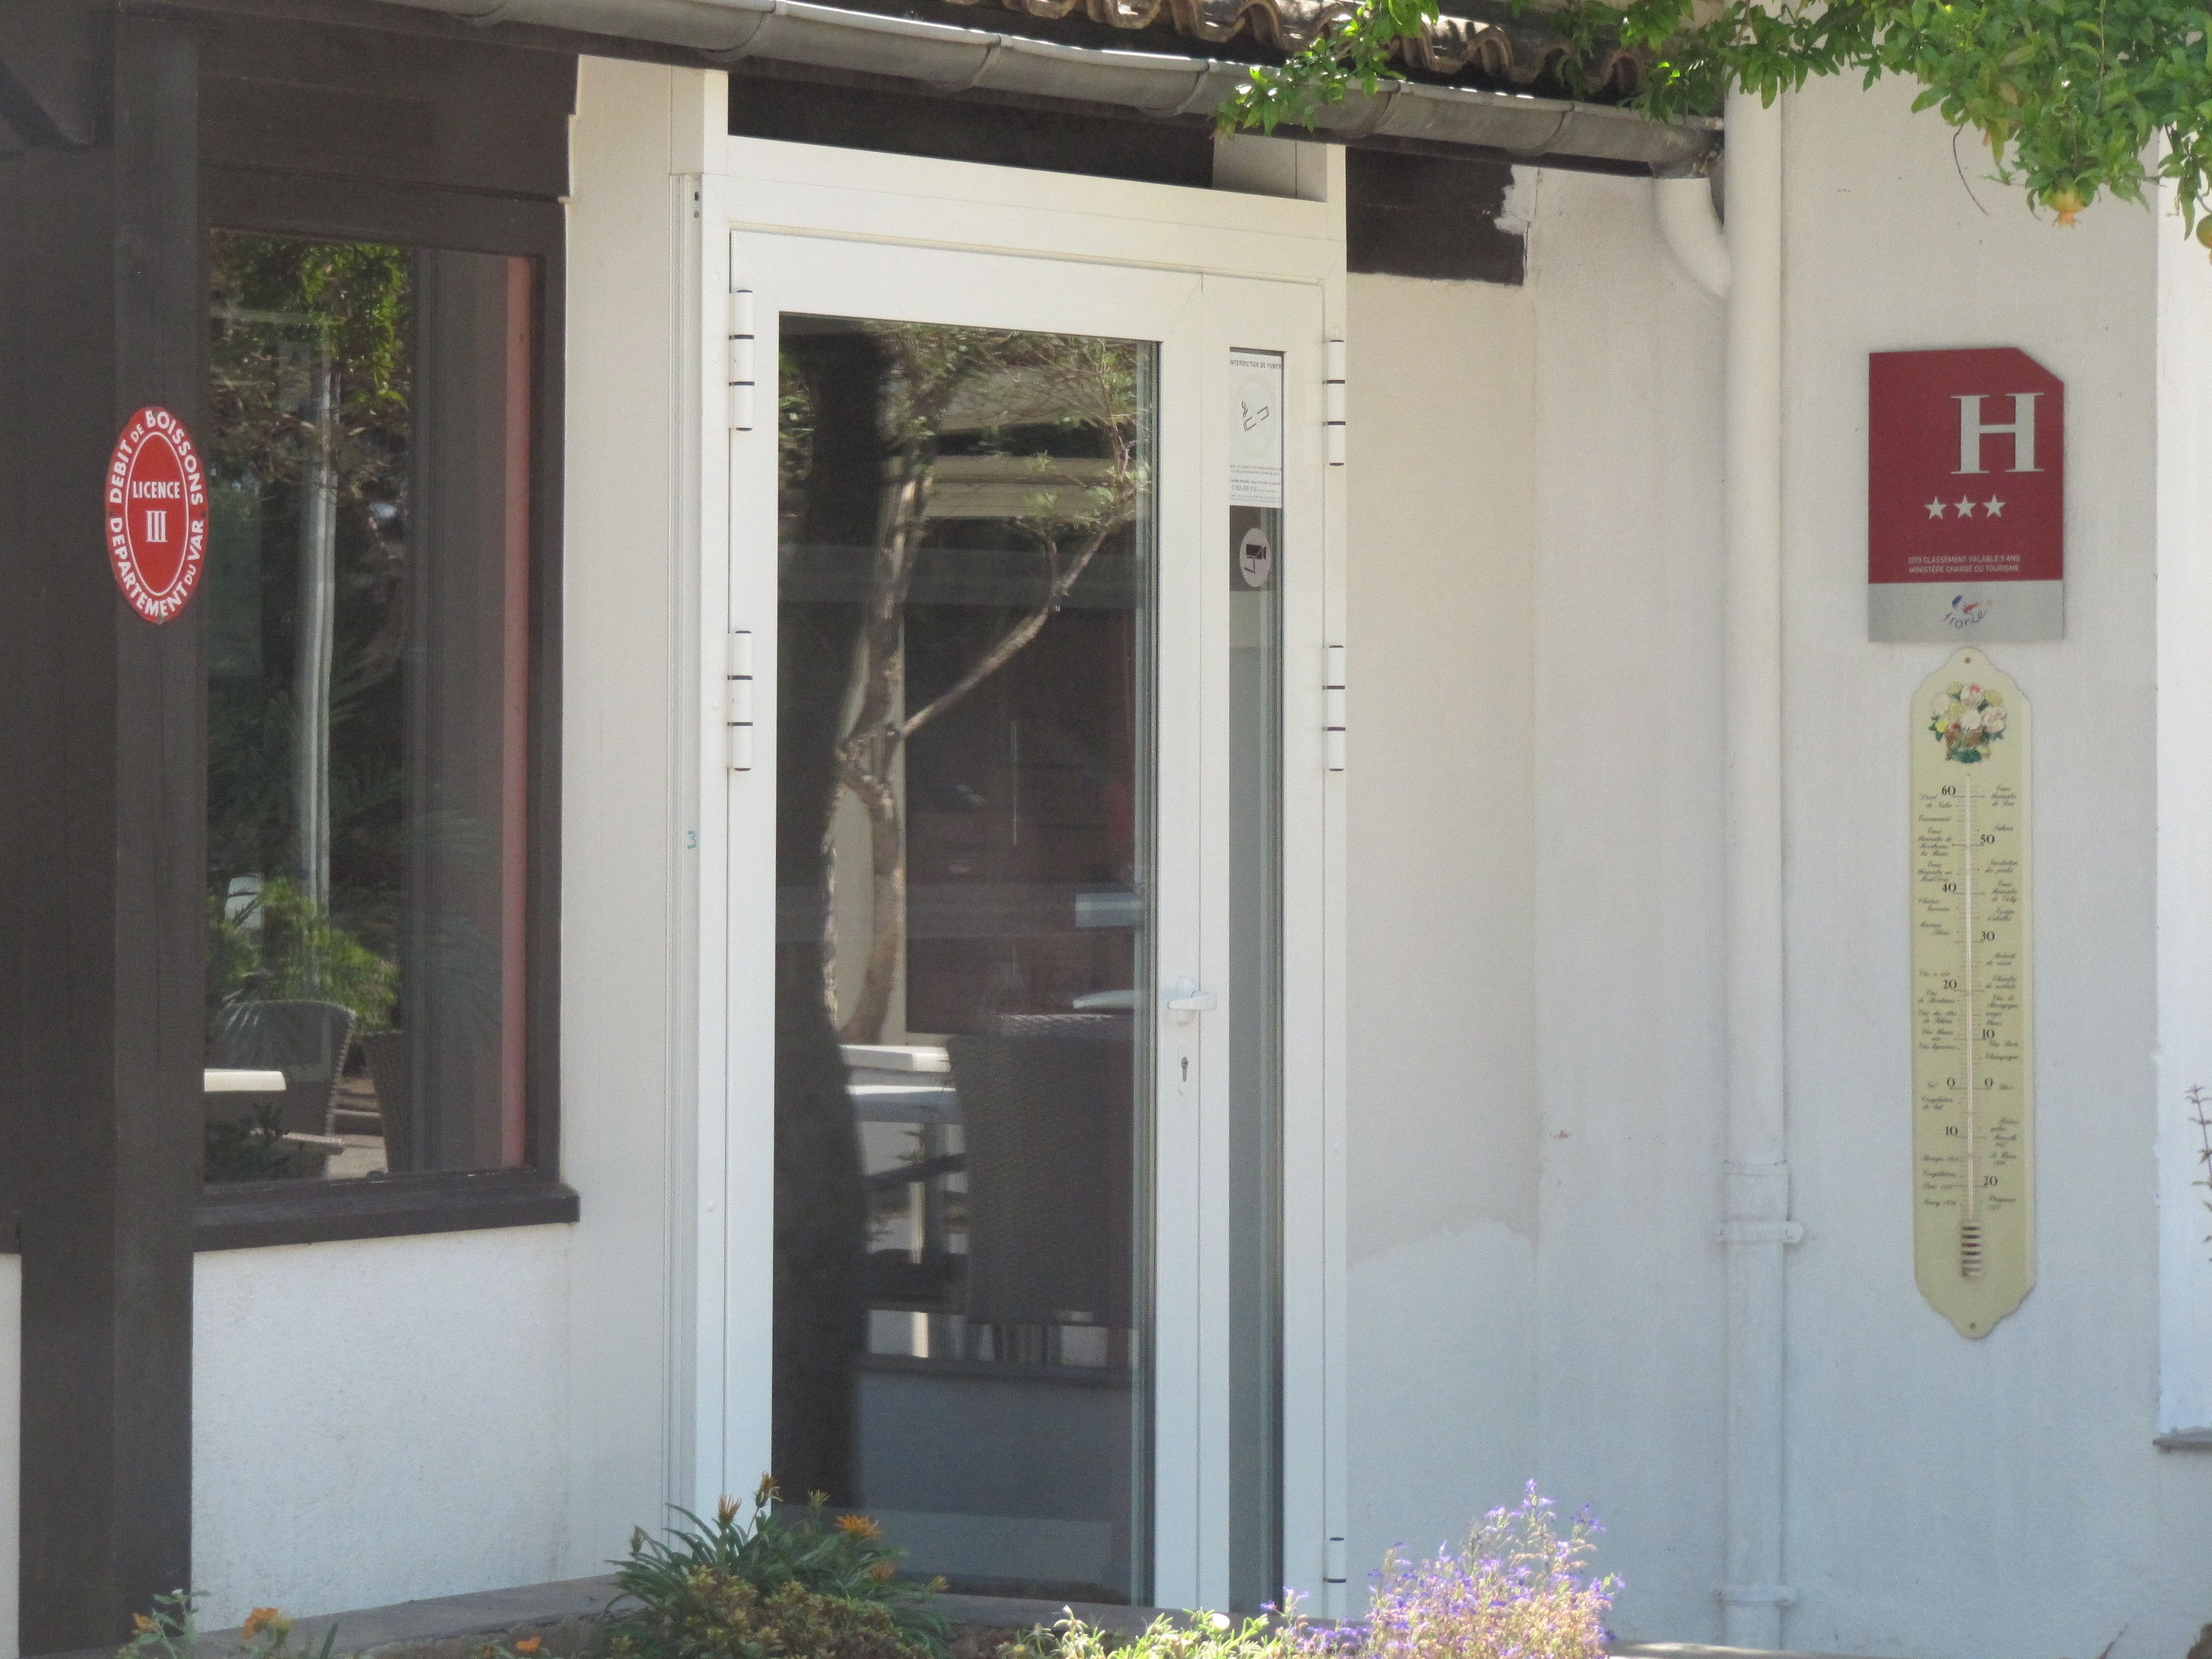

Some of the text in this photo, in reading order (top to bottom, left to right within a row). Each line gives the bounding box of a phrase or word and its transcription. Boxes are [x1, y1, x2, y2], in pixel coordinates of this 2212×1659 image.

[1950, 393, 2044, 474] H
[109, 410, 203, 505] DEBIT DE BOISSONS
[133, 482, 180, 499] LICENCE
[146, 511, 167, 543] III
[111, 517, 204, 616] DEPARTEMENT DU VAR
[1941, 785, 1956, 795] 60
[1980, 834, 1995, 844] 50
[1942, 883, 1957, 892] 40
[1981, 931, 1995, 941] 30
[1943, 979, 1957, 989] 20
[1982, 1029, 1995, 1039] 10
[1947, 1077, 1955, 1088] 0
[1984, 1077, 1993, 1088] 0
[1946, 1126, 1958, 1135] 10
[1984, 1176, 1998, 1185] 20
